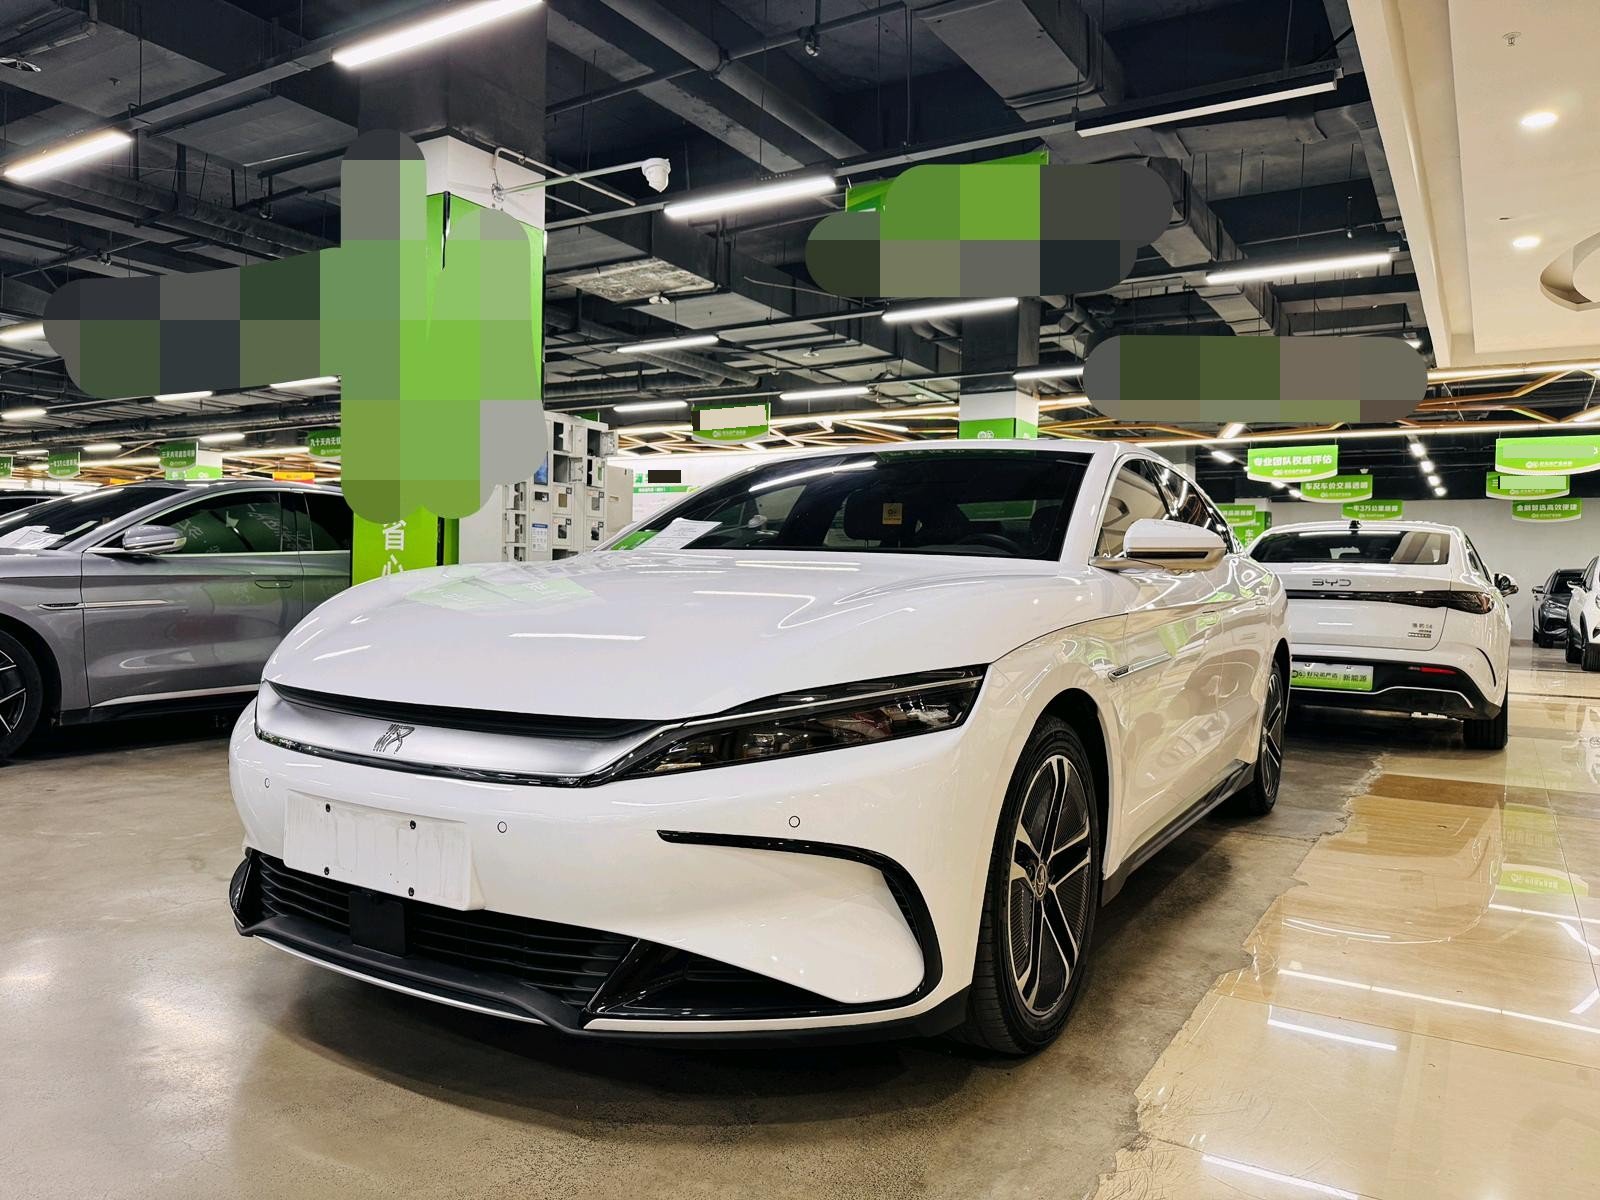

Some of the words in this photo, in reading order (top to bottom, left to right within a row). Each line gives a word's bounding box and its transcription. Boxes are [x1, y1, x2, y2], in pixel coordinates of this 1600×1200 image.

[1255, 454, 1332, 466] 专业团队权威评估
